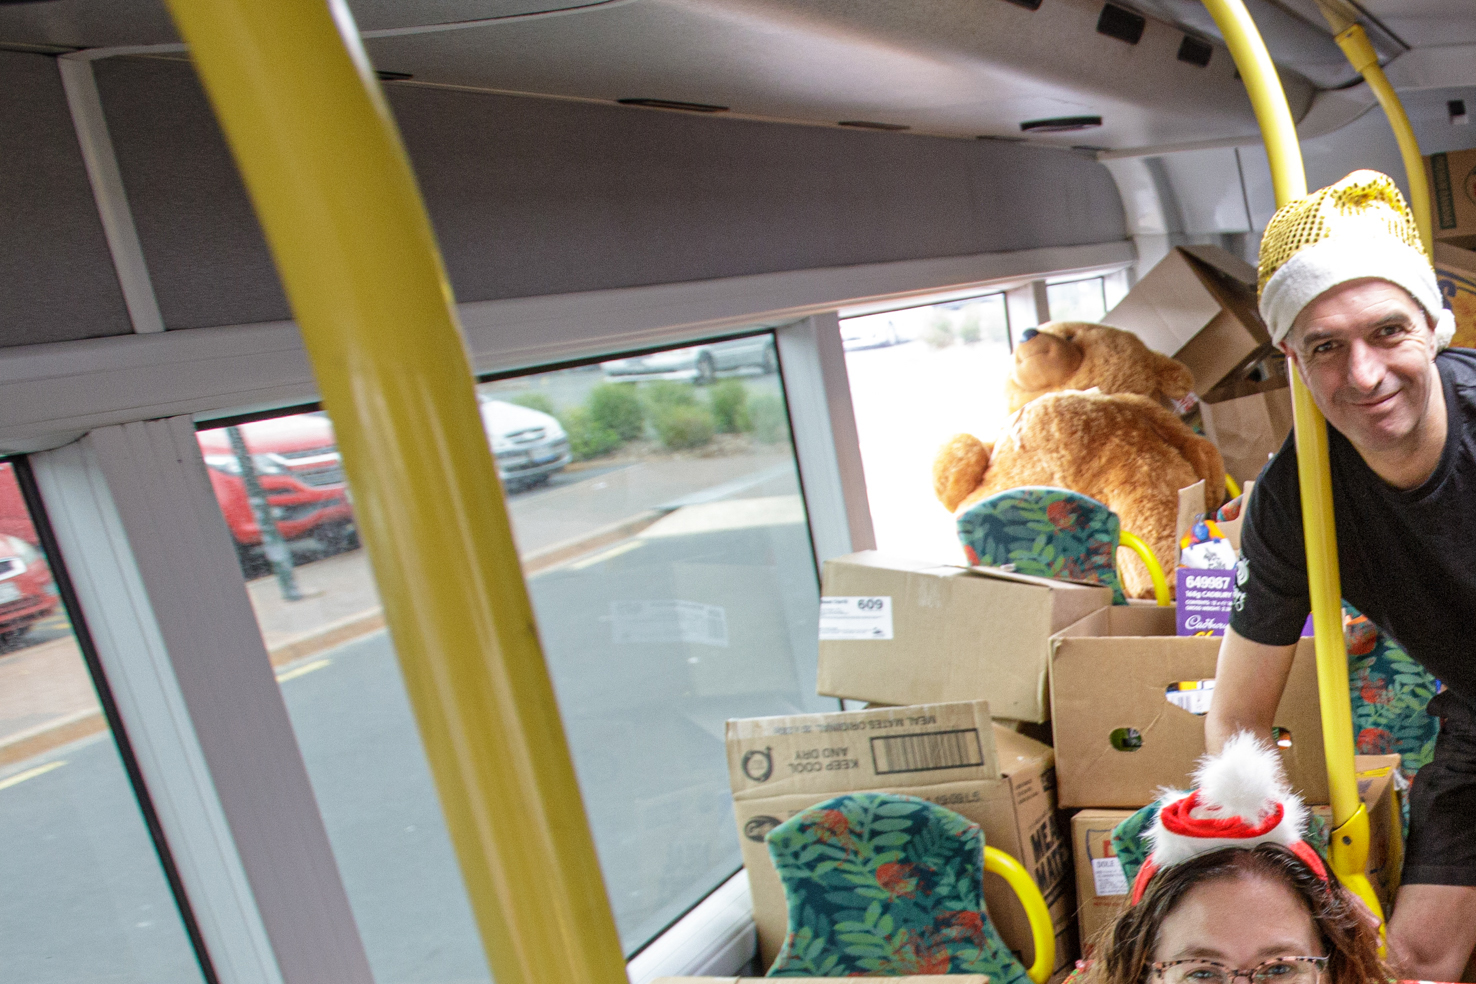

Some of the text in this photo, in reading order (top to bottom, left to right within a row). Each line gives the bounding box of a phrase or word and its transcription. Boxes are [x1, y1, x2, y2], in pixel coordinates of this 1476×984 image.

[857, 598, 884, 610] 609
[1184, 614, 1227, 631] Cadbur
[793, 746, 849, 762] AND DRY
[788, 759, 860, 775] KEEP COOL
